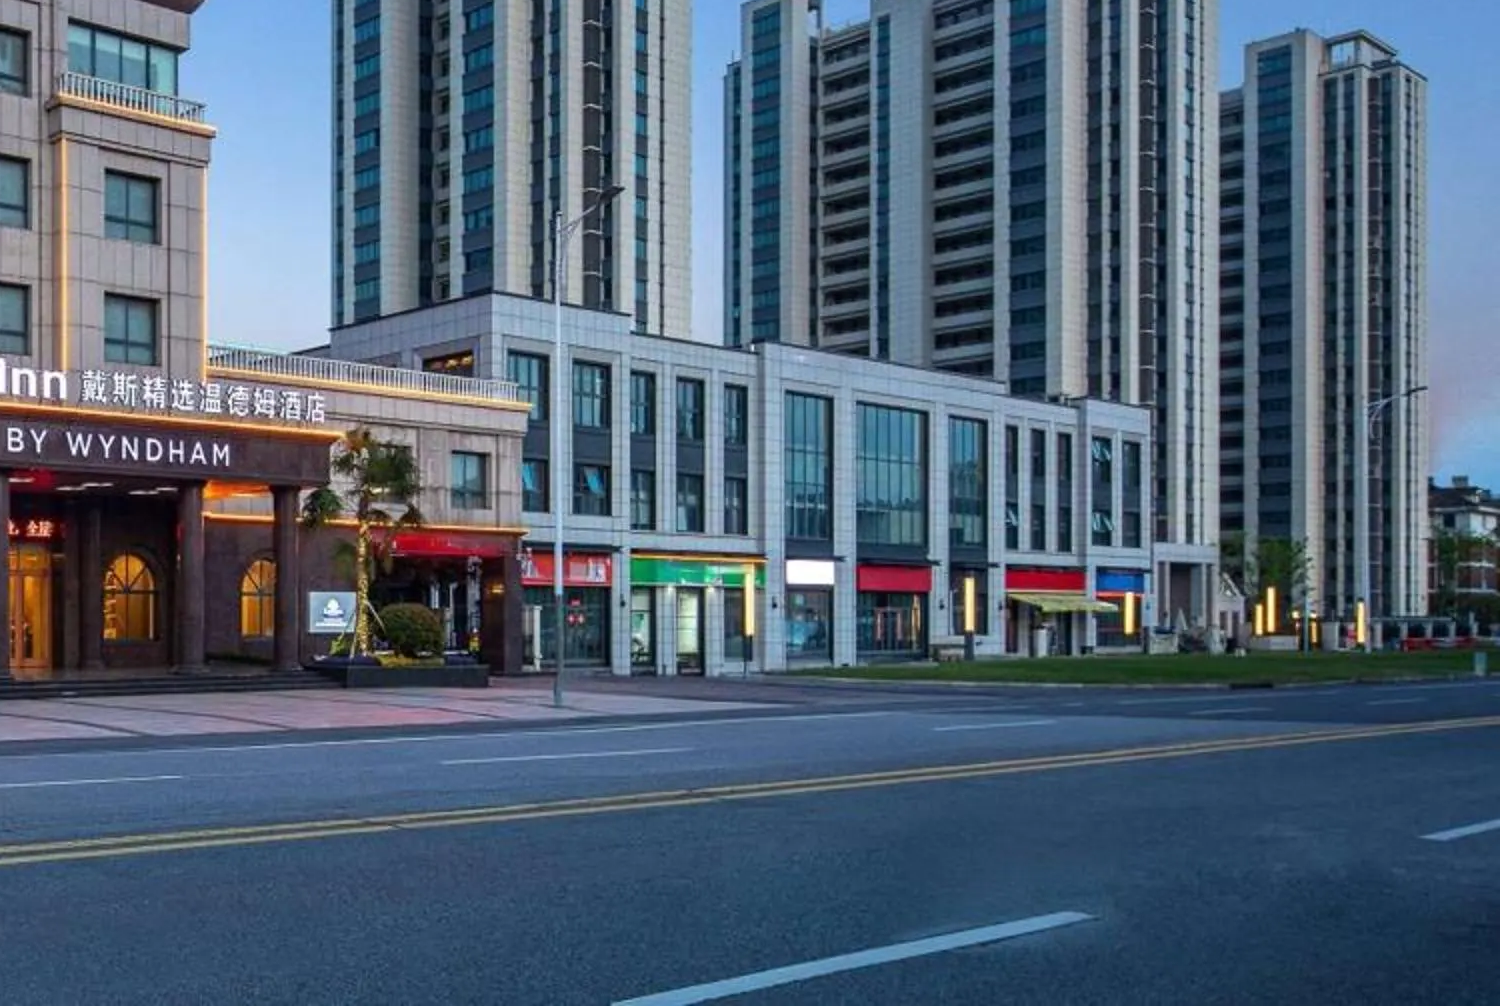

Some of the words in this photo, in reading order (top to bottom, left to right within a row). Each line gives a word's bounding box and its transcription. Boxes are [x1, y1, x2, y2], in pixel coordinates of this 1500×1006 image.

[81, 370, 326, 423] 戴斯精选温德姆酒店
[7, 427, 47, 453] BY
[66, 431, 230, 466] WYNDHAM
